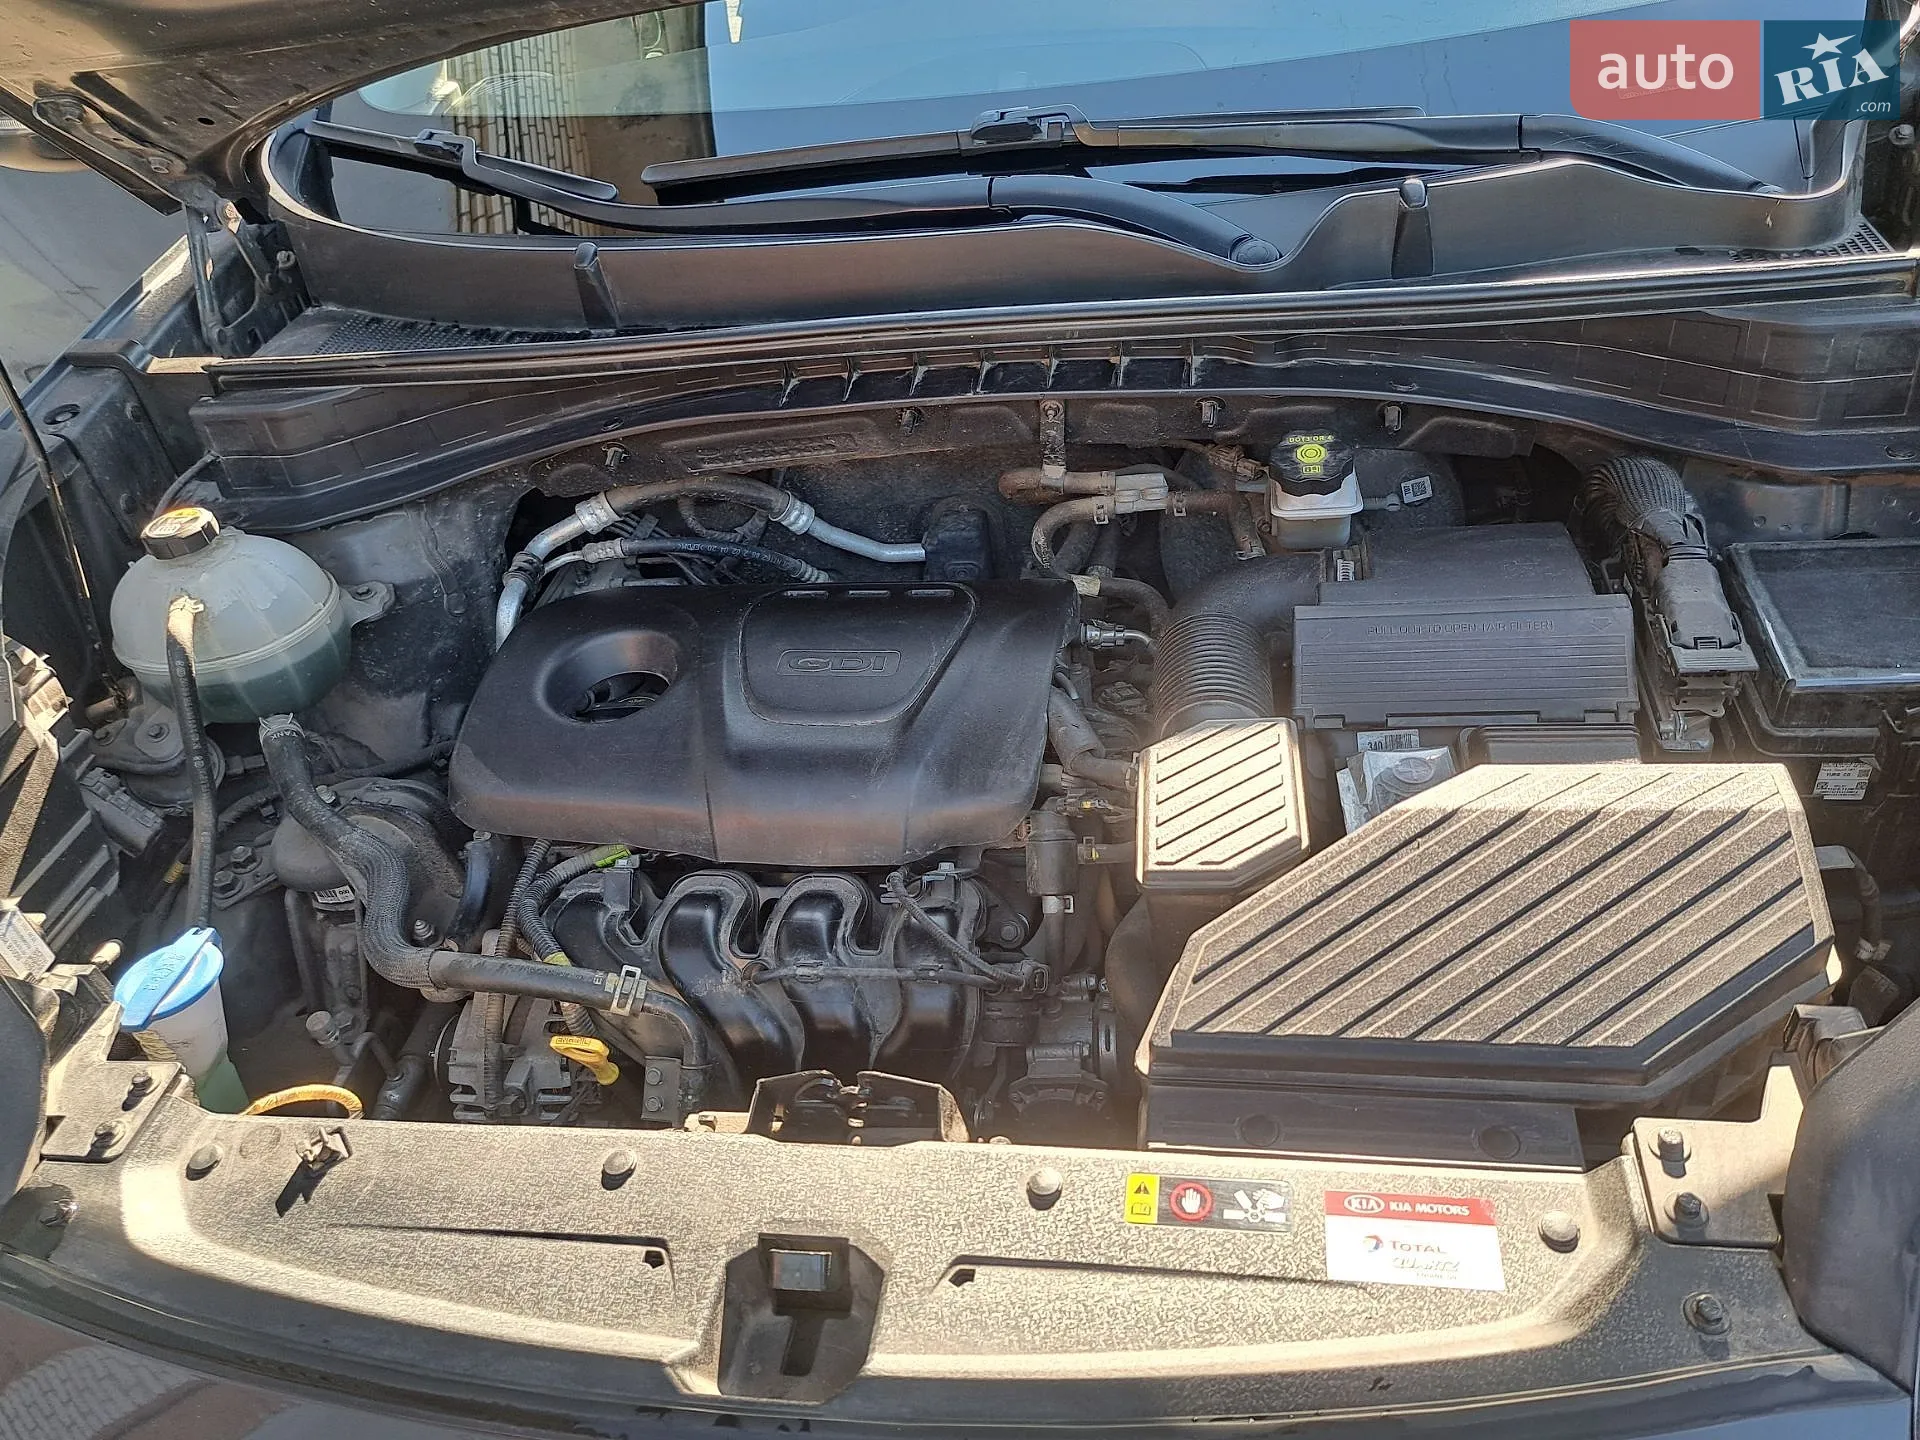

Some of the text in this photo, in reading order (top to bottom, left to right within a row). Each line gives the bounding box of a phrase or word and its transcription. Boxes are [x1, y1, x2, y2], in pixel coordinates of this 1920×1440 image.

[1368, 624, 1396, 635] PULL
[1399, 623, 1422, 634] OUT
[1427, 622, 1442, 633] TO
[1444, 622, 1477, 633] OPEN
[788, 655, 887, 672] GDI
[1349, 1197, 1380, 1212] KIA
[1389, 1201, 1470, 1216] KIA MOTORS
[1389, 1240, 1448, 1254] TOTAL
